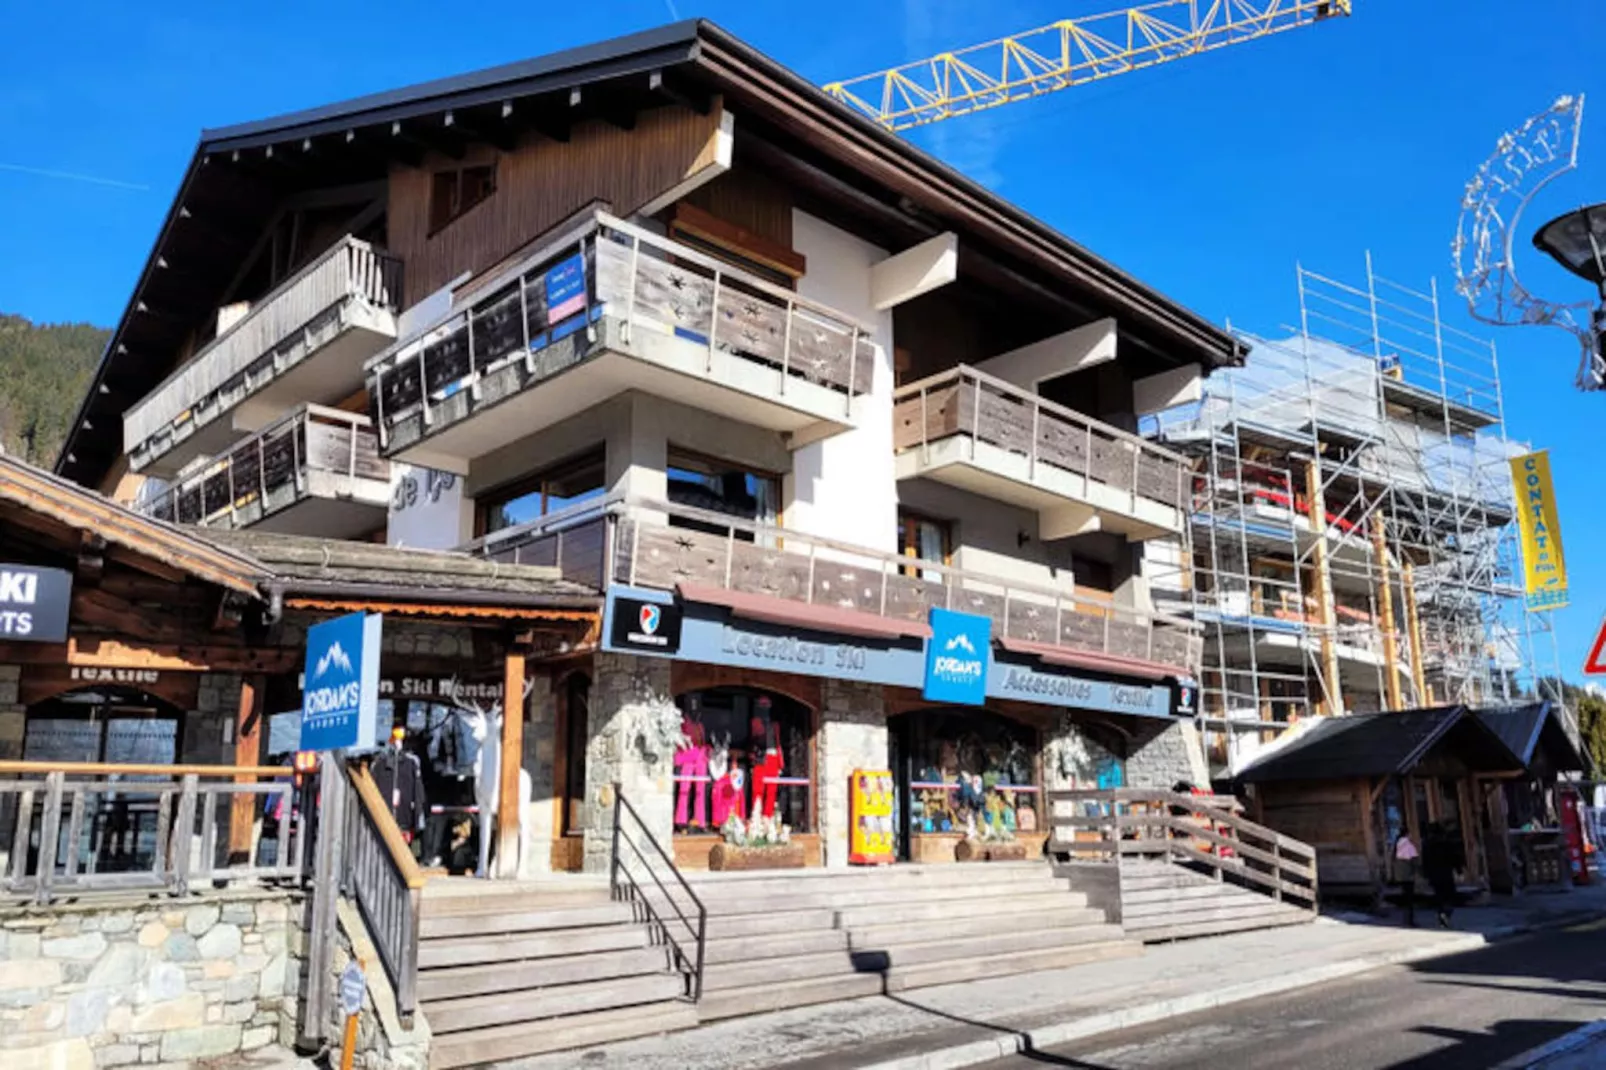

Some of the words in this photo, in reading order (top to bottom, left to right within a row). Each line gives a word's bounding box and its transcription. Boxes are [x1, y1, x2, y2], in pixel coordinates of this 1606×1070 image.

[0, 610, 33, 635] TS
[401, 677, 433, 695] Ski
[438, 678, 504, 699] Rental
[1003, 667, 1093, 700] Accessoires
